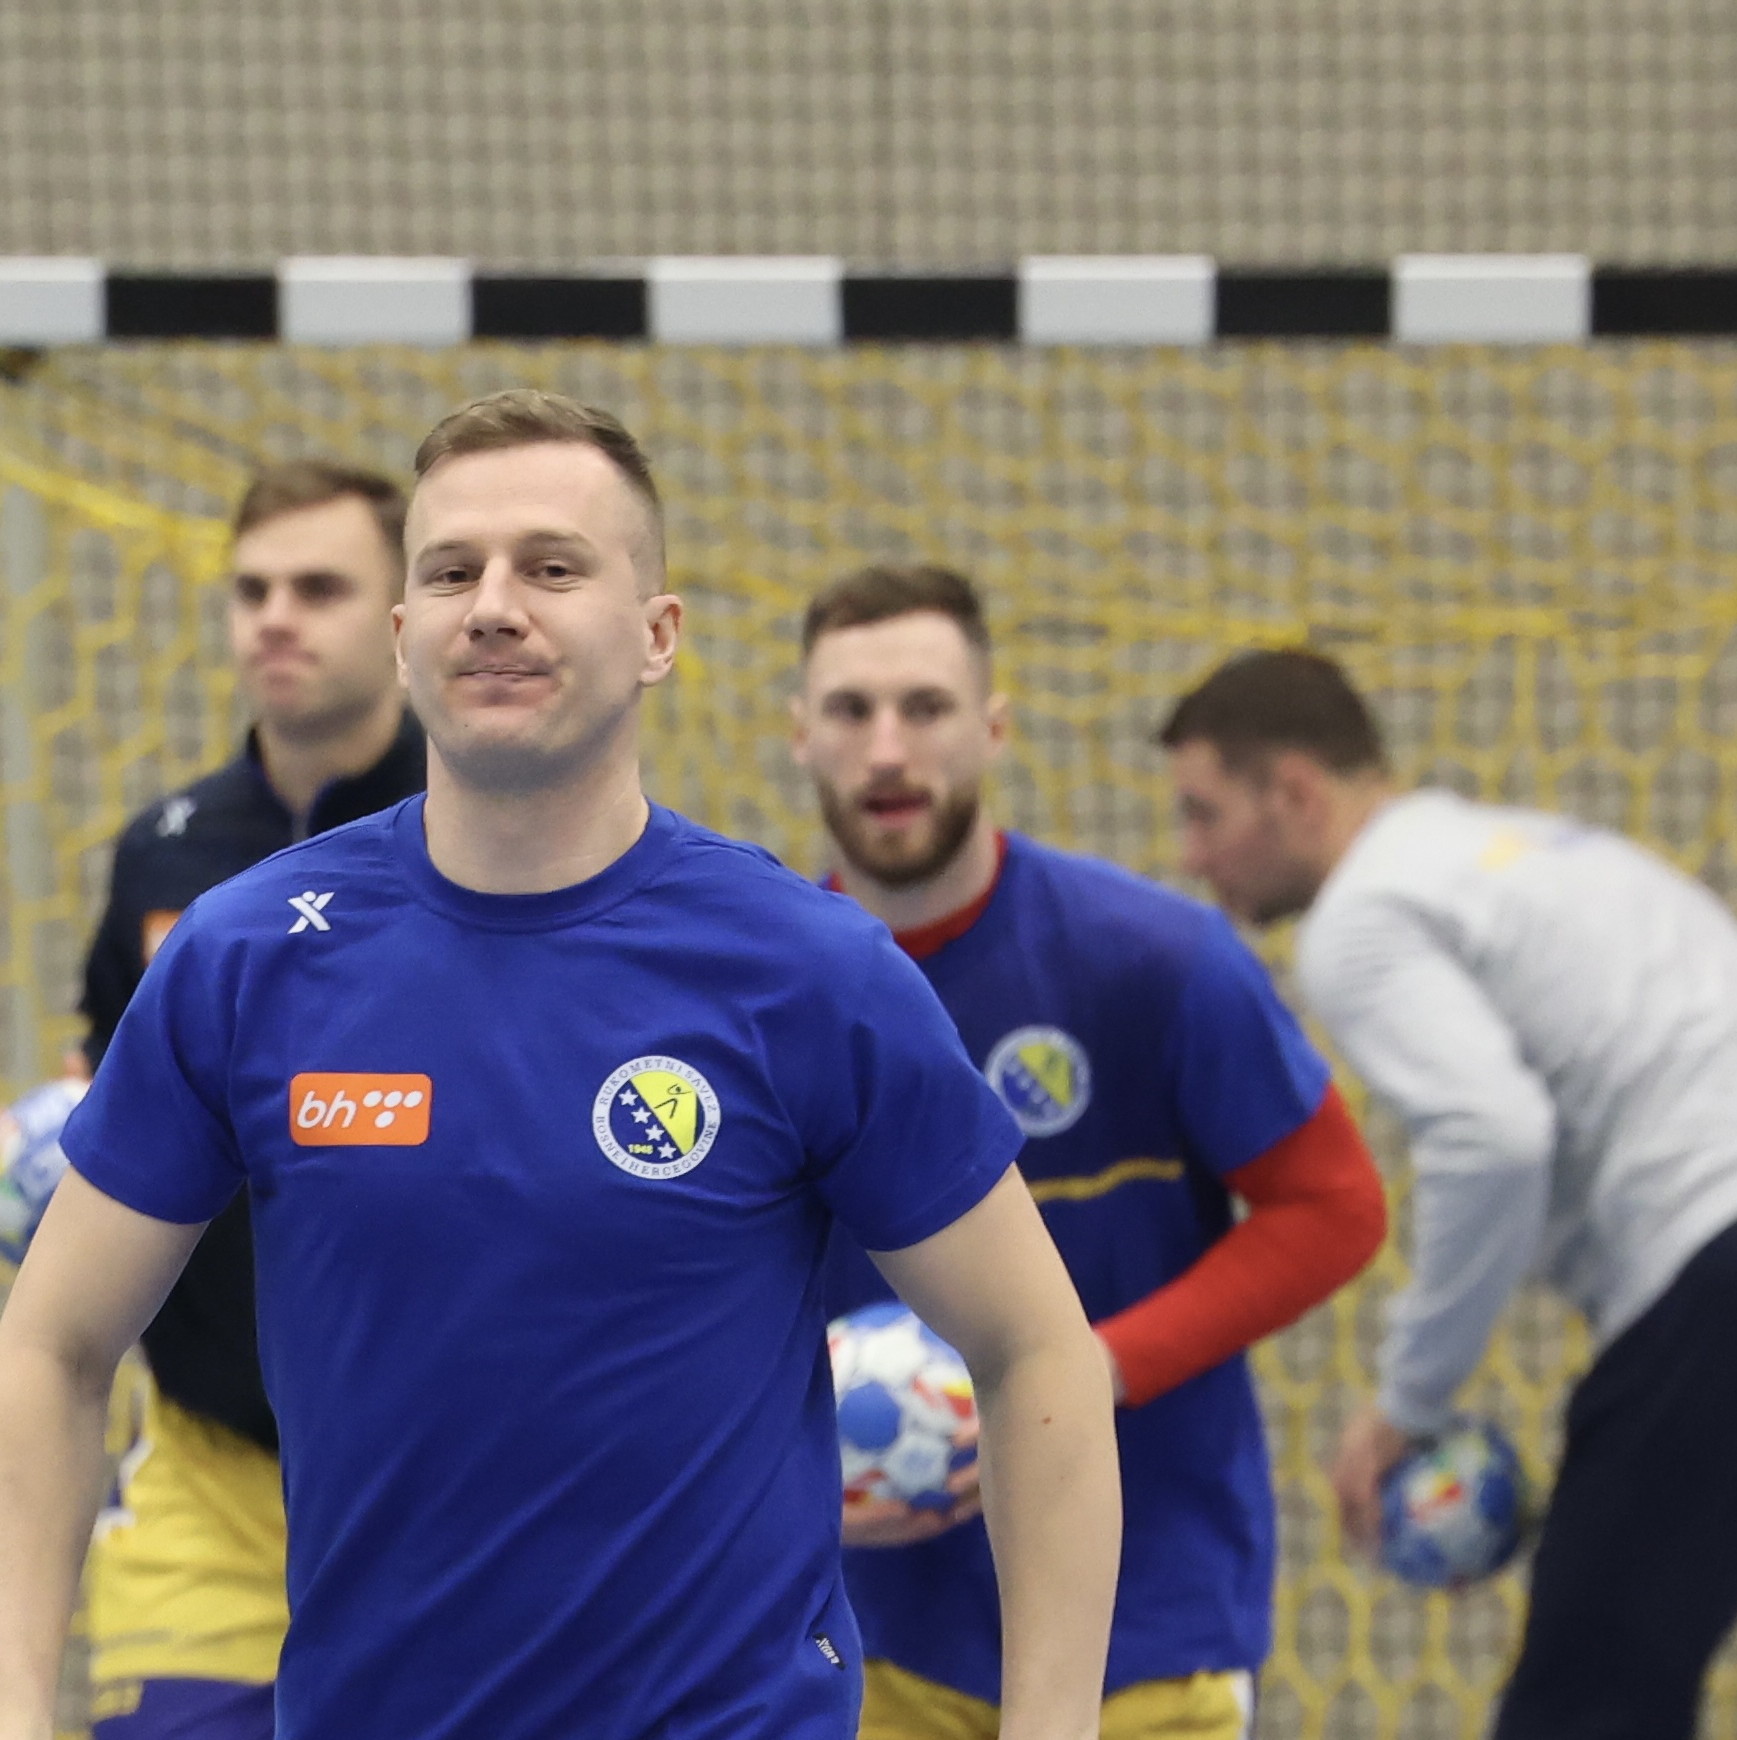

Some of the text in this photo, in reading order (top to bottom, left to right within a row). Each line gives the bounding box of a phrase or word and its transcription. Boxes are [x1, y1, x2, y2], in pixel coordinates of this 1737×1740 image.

[297, 1090, 355, 1129] bh
[599, 1059, 717, 1112] RUKOMETNI SAVEZ
[595, 1116, 620, 1160] BOSNE
[629, 1121, 717, 1176] HERCEGOVINE
